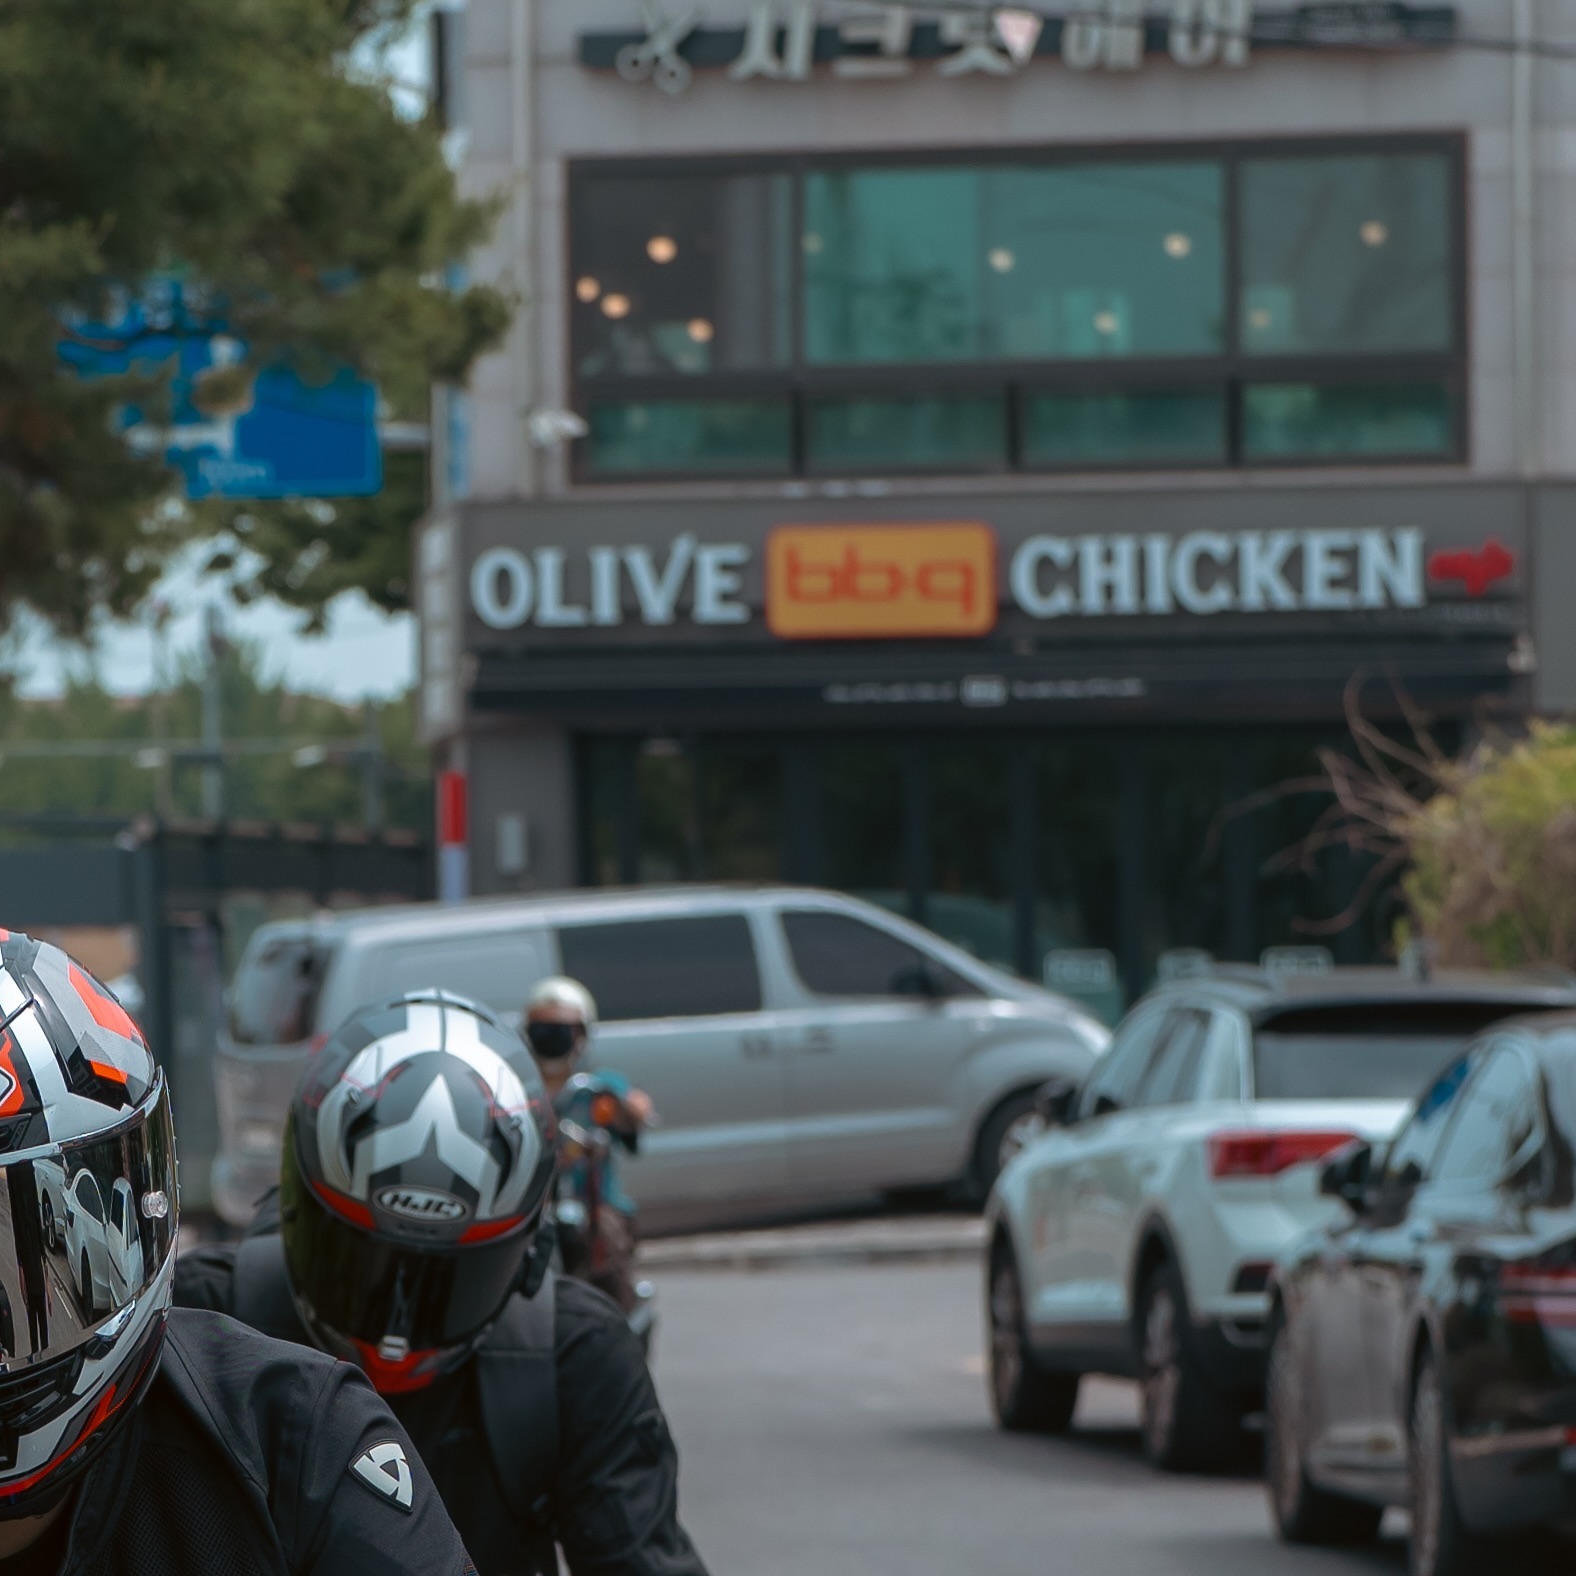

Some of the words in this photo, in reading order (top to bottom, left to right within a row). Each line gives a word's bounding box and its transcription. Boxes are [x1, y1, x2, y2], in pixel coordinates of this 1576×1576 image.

[470, 534, 751, 628] OLIVE
[784, 542, 977, 617] bbq
[1010, 526, 1421, 618] CHICKEN
